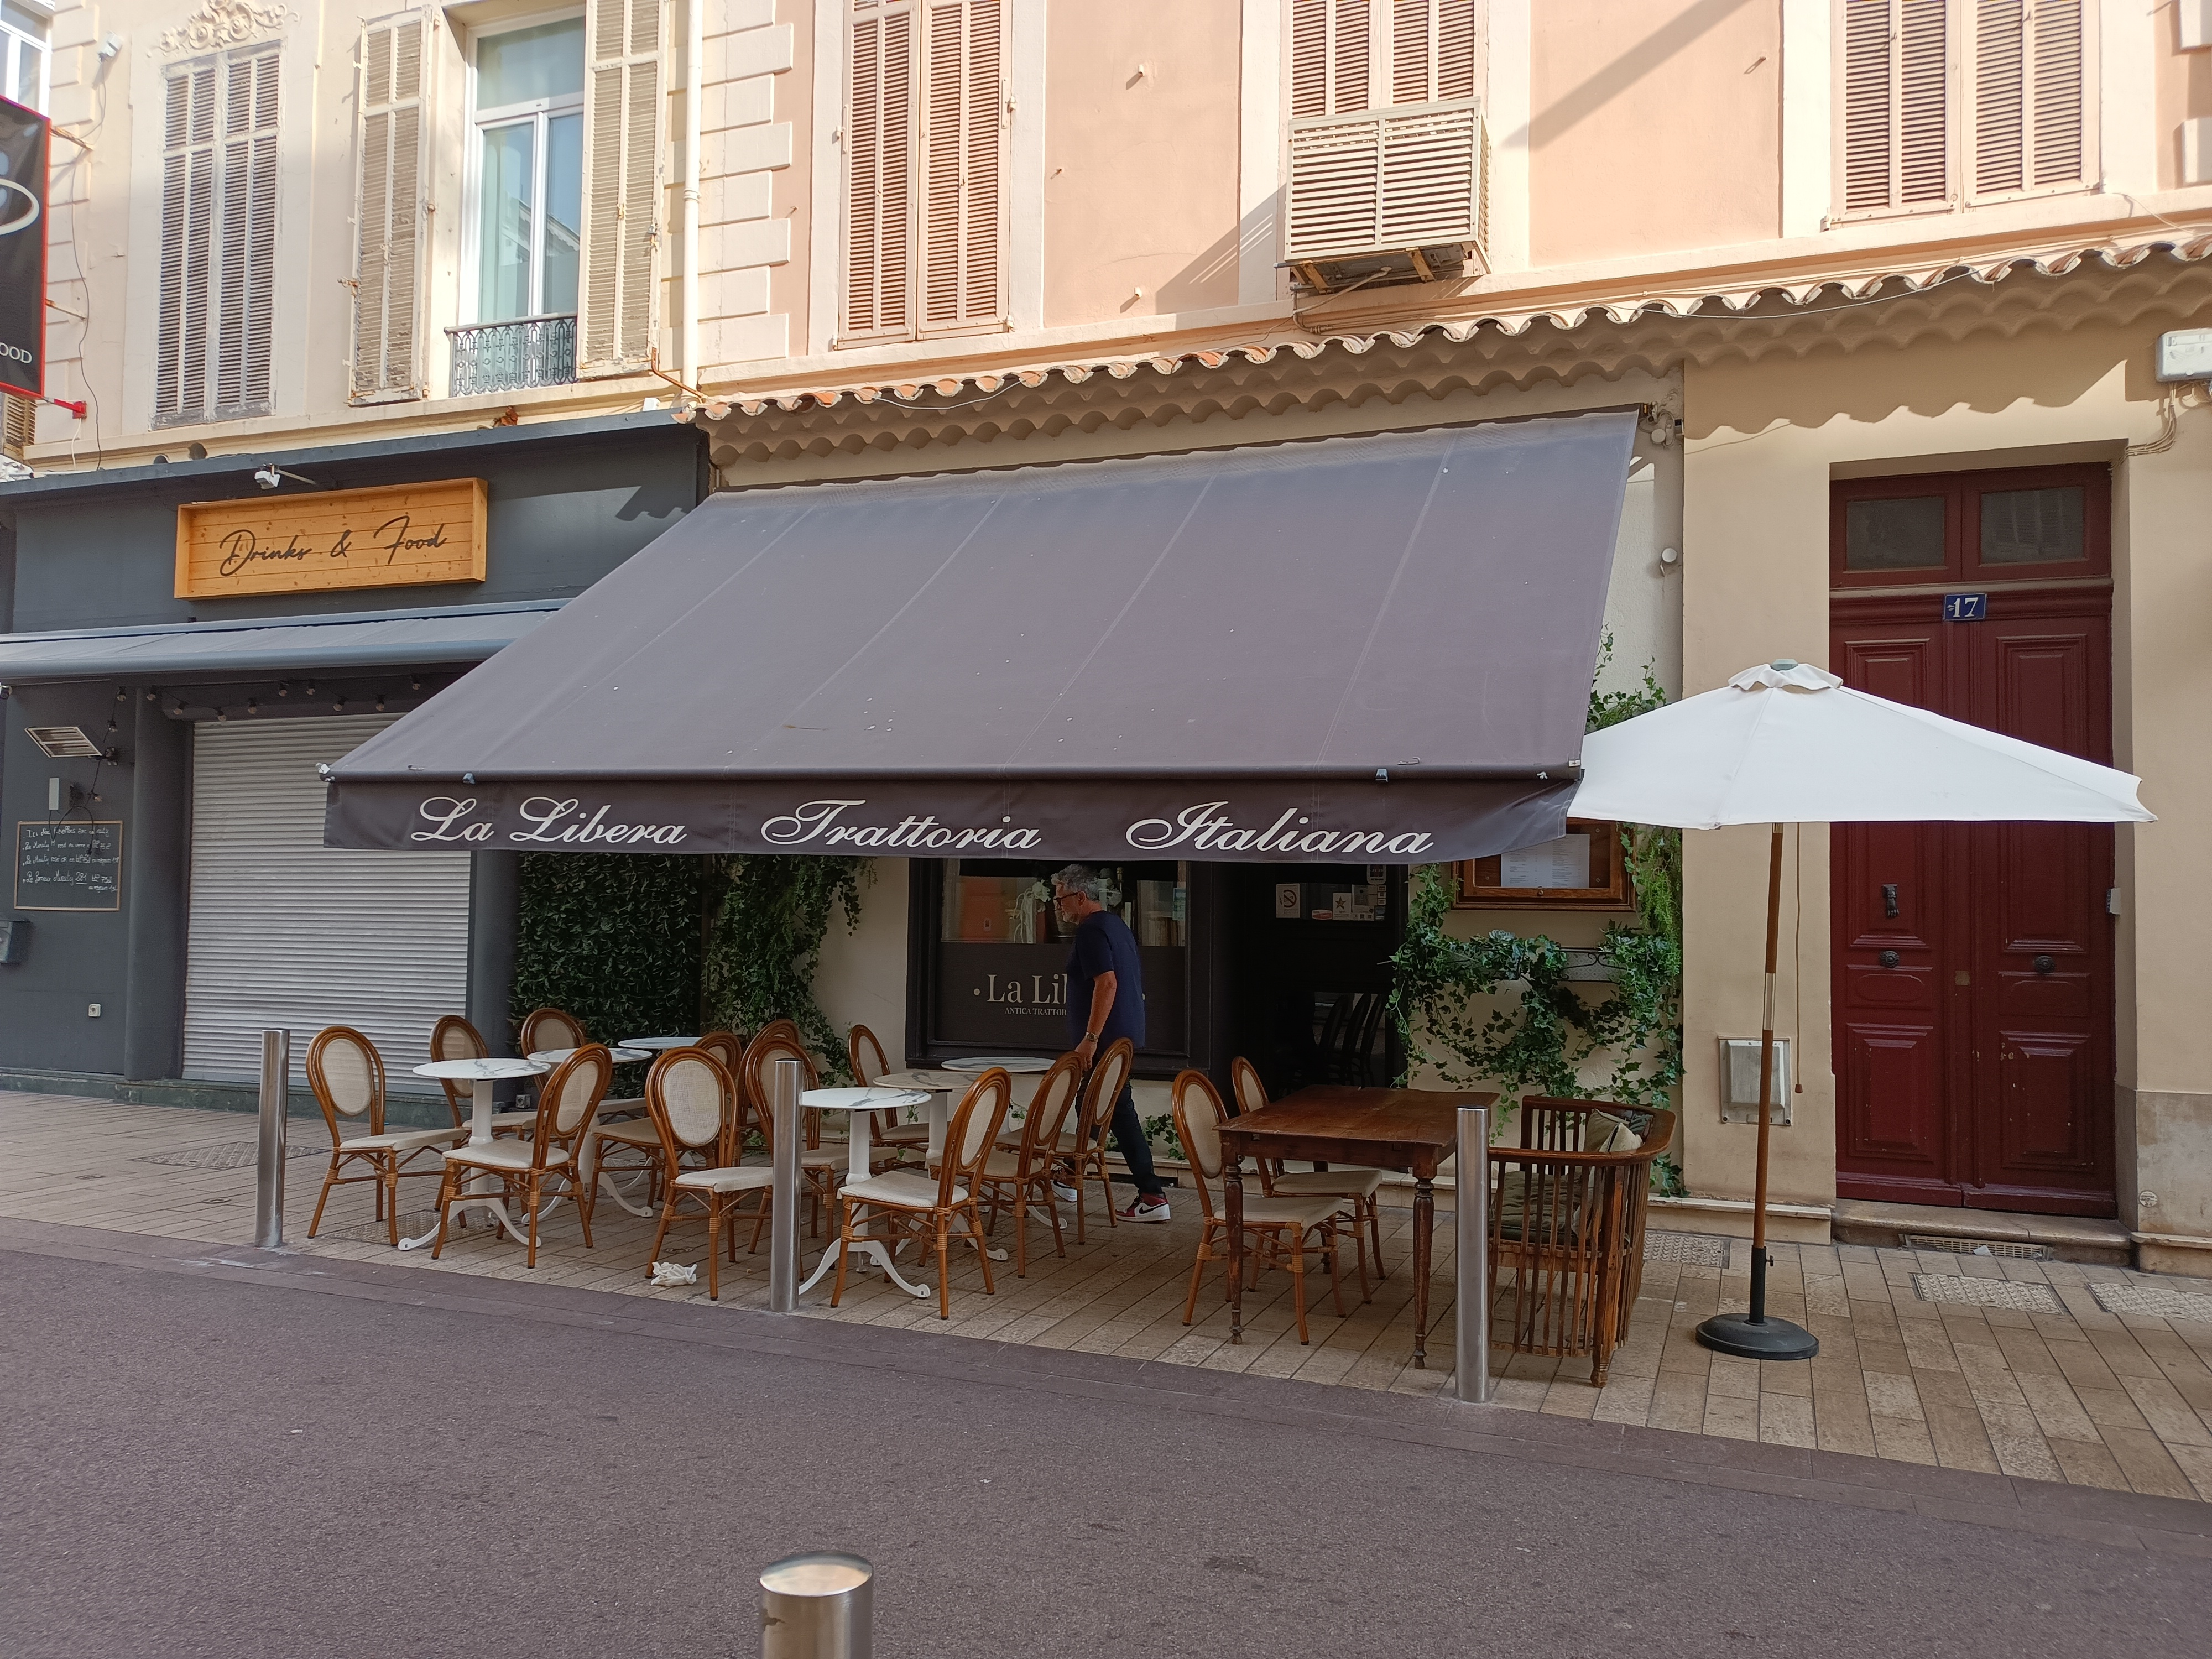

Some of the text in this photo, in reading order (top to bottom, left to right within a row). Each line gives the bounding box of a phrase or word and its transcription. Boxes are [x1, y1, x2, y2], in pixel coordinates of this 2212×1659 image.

[219, 515, 447, 577] Drinks & Food
[1953, 597, 1979, 618] 17
[410, 796, 1434, 854] La Libera Trattoria Italiana
[987, 974, 1023, 1003] La
